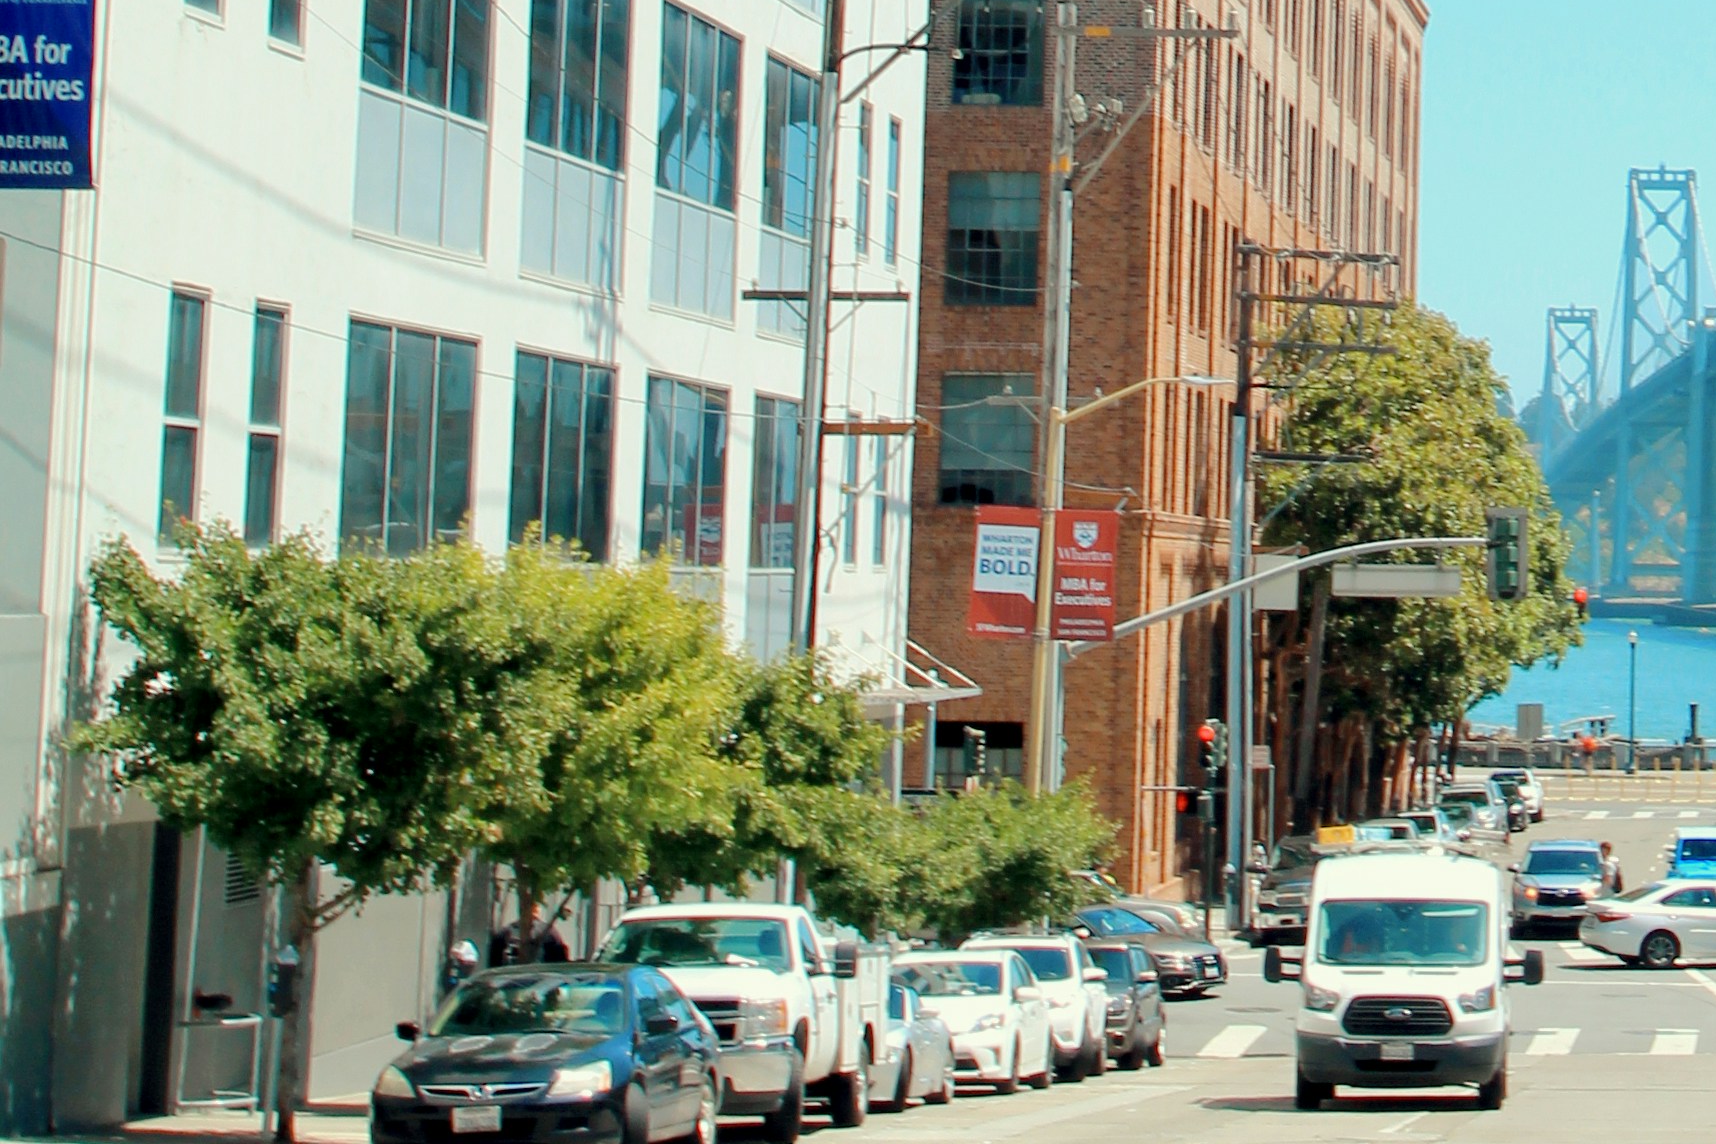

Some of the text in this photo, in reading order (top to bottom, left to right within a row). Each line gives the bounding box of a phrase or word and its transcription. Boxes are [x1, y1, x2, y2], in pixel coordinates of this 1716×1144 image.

[33, 34, 73, 65] for
[981, 545, 1032, 558] MADE ME
[1057, 547, 1112, 561] Wharton
[1060, 577, 1107, 592] MBA for
[1054, 591, 1113, 607] Executives
